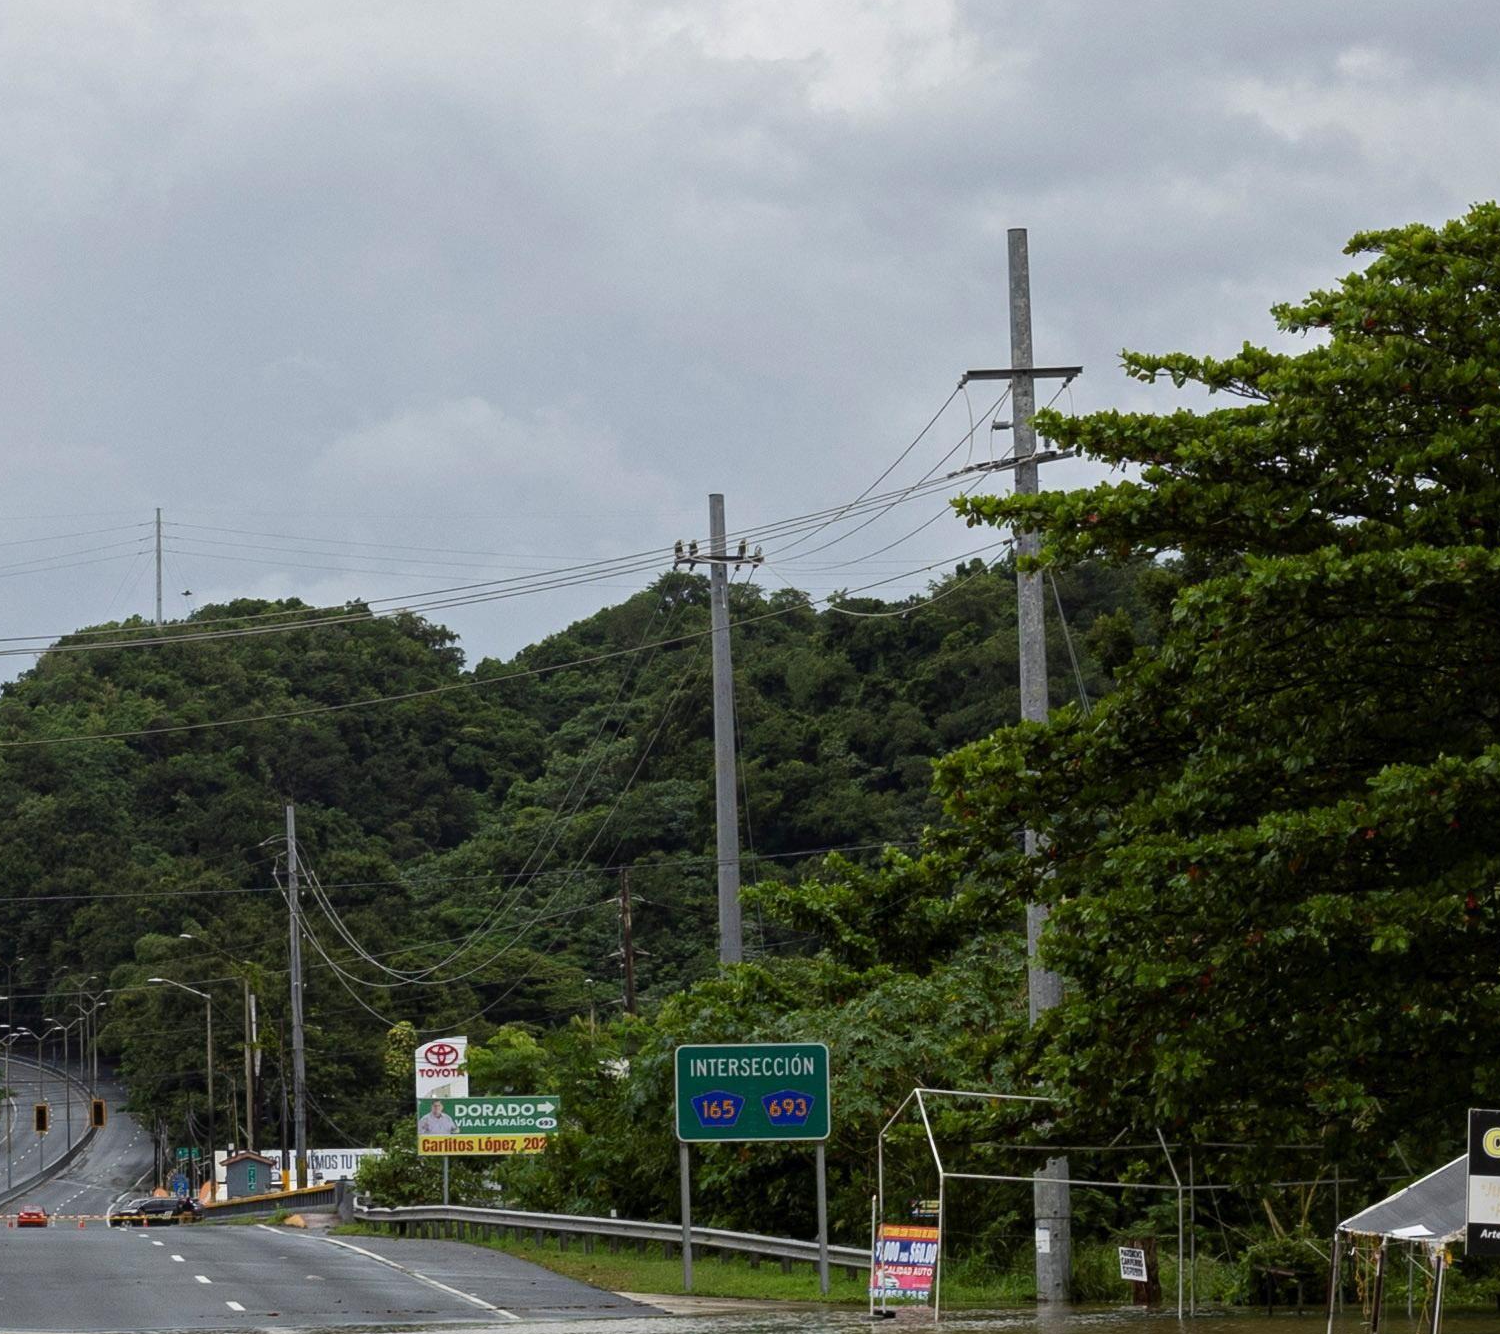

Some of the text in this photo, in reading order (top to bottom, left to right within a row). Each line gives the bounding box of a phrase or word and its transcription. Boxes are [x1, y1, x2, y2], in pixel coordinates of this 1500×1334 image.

[690, 1053, 814, 1077] INTERSECCIÓN
[419, 1068, 465, 1078] TOYOTA
[454, 1104, 535, 1117] DORADO
[702, 1099, 735, 1118] 165
[769, 1098, 807, 1117] 693
[489, 1117, 535, 1127] PARAÍSO
[422, 1138, 474, 1153] Carlitos
[478, 1137, 517, 1153] López
[913, 1267, 933, 1277] AUTO
